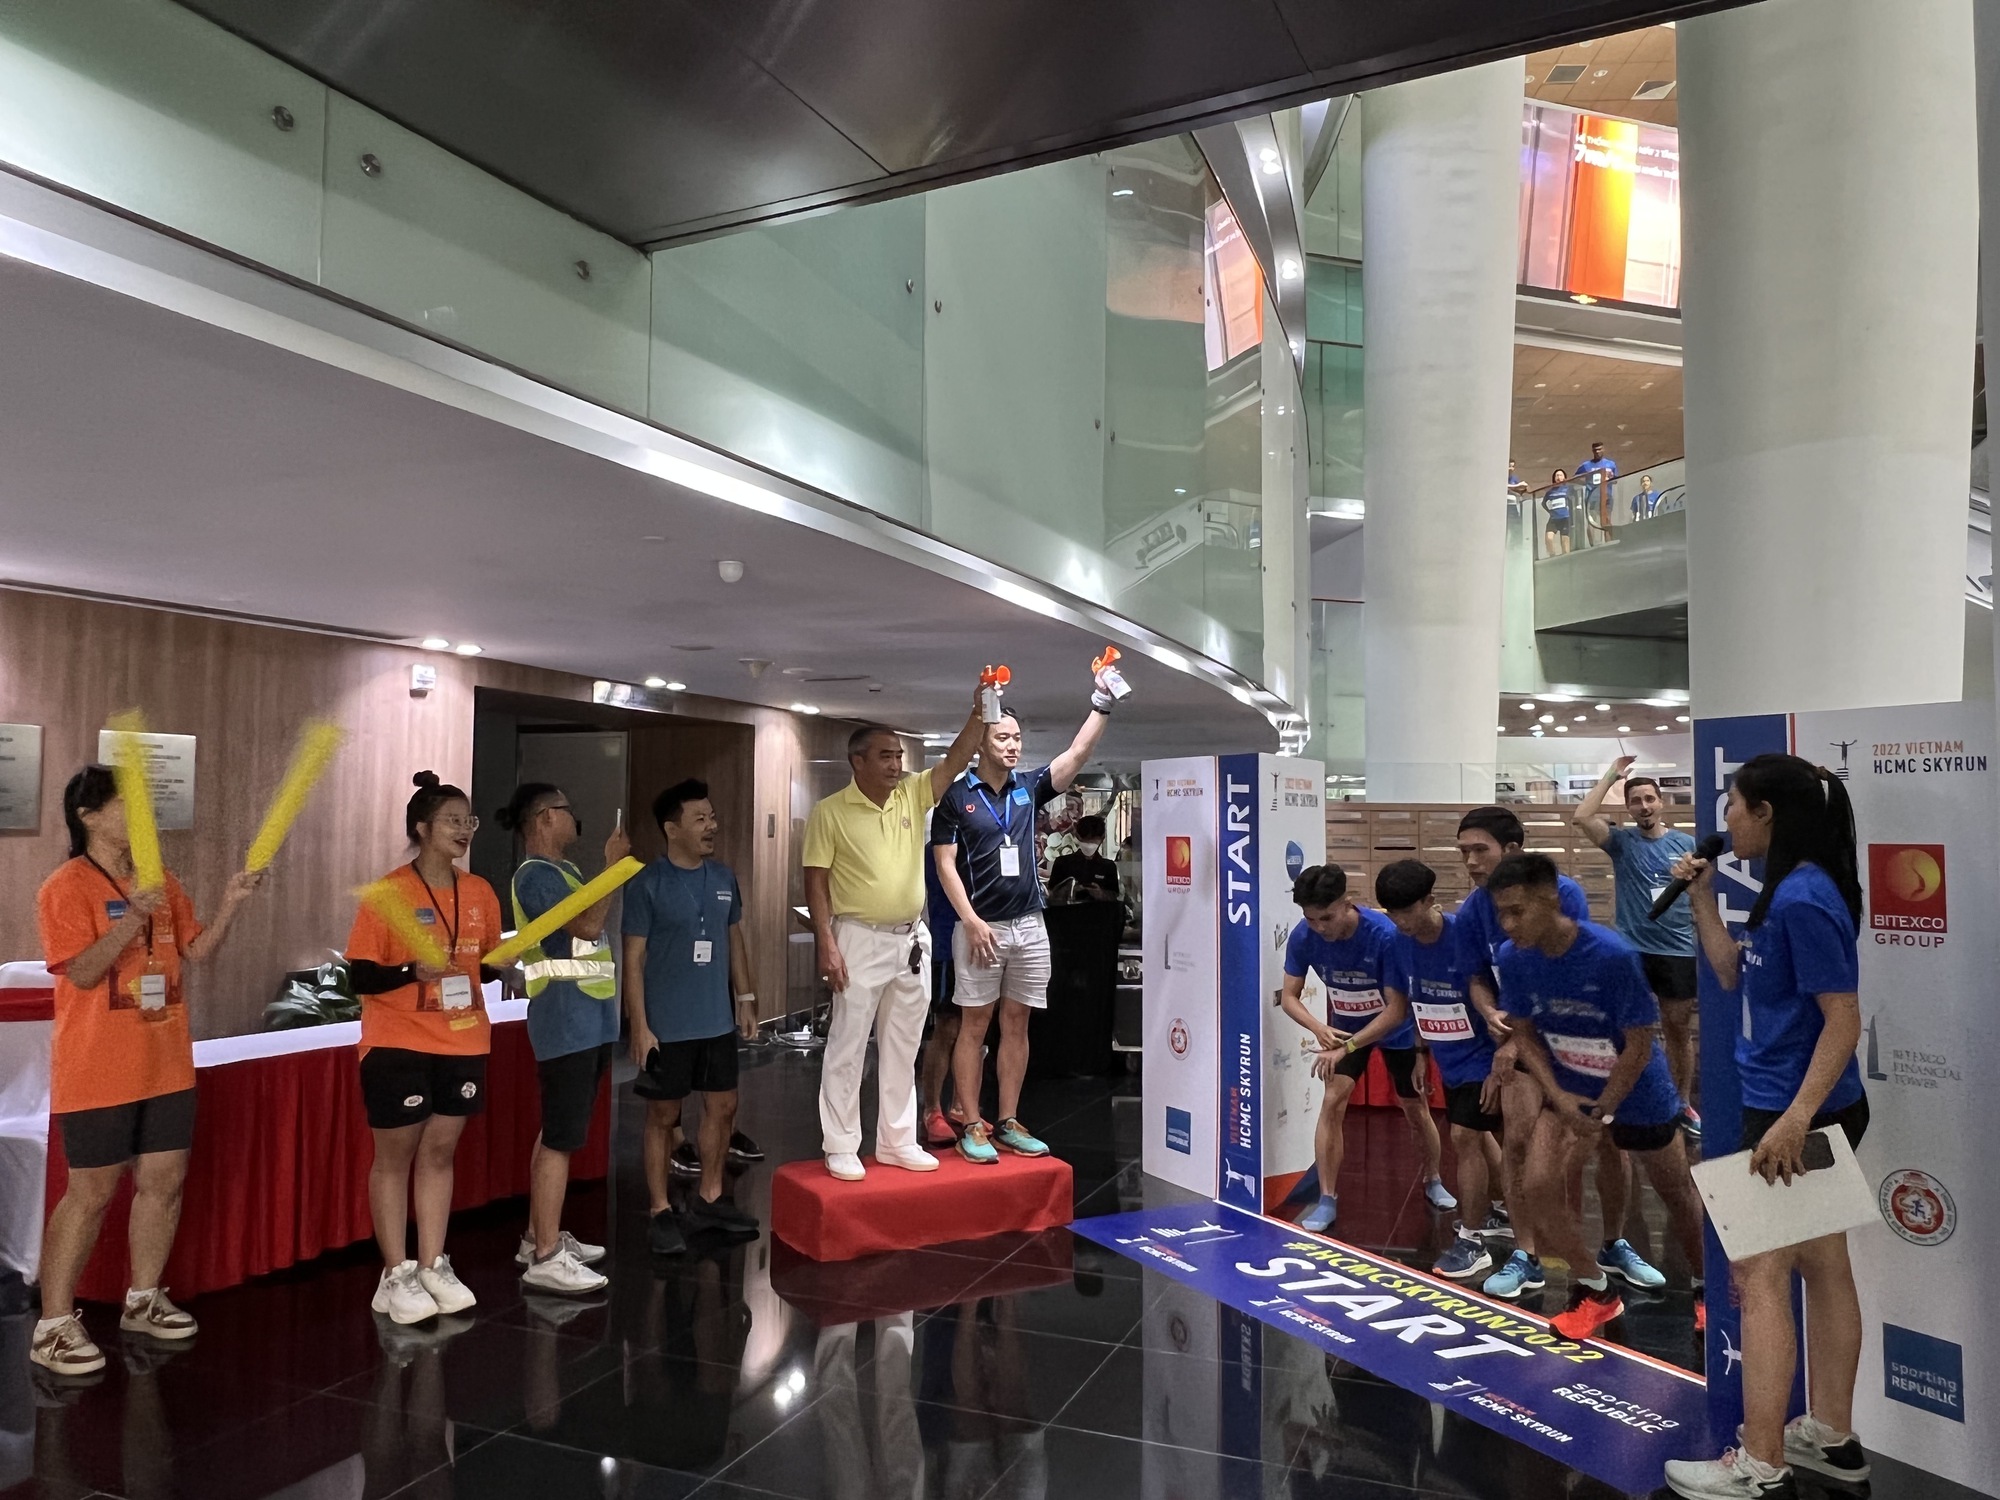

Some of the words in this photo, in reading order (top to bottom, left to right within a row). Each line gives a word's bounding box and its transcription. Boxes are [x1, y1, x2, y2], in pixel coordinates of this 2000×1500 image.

[1872, 743, 1901, 756] 2022
[1905, 740, 1964, 755] VIETNAM
[1873, 758, 1917, 774] HCMC
[1923, 755, 1987, 772] SKYRUN
[1227, 774, 1250, 926] START
[1874, 914, 1945, 930] BITEXCO
[1874, 933, 1945, 948] GROUP
[1240, 1033, 1251, 1097] SKYRUN
[1240, 1103, 1251, 1149] HCMC
[1235, 1257, 1536, 1359] START
[1282, 1241, 1605, 1363] #HCMCSKYRUN2022
[1891, 1361, 1957, 1393] sporting
[1891, 1374, 1958, 1408] REPUBLIC
[1467, 1395, 1514, 1416] HCMC
[1509, 1413, 1574, 1443] SKYRUN
[1552, 1387, 1664, 1434] REPUBLIC
[1572, 1382, 1680, 1428] sporting
